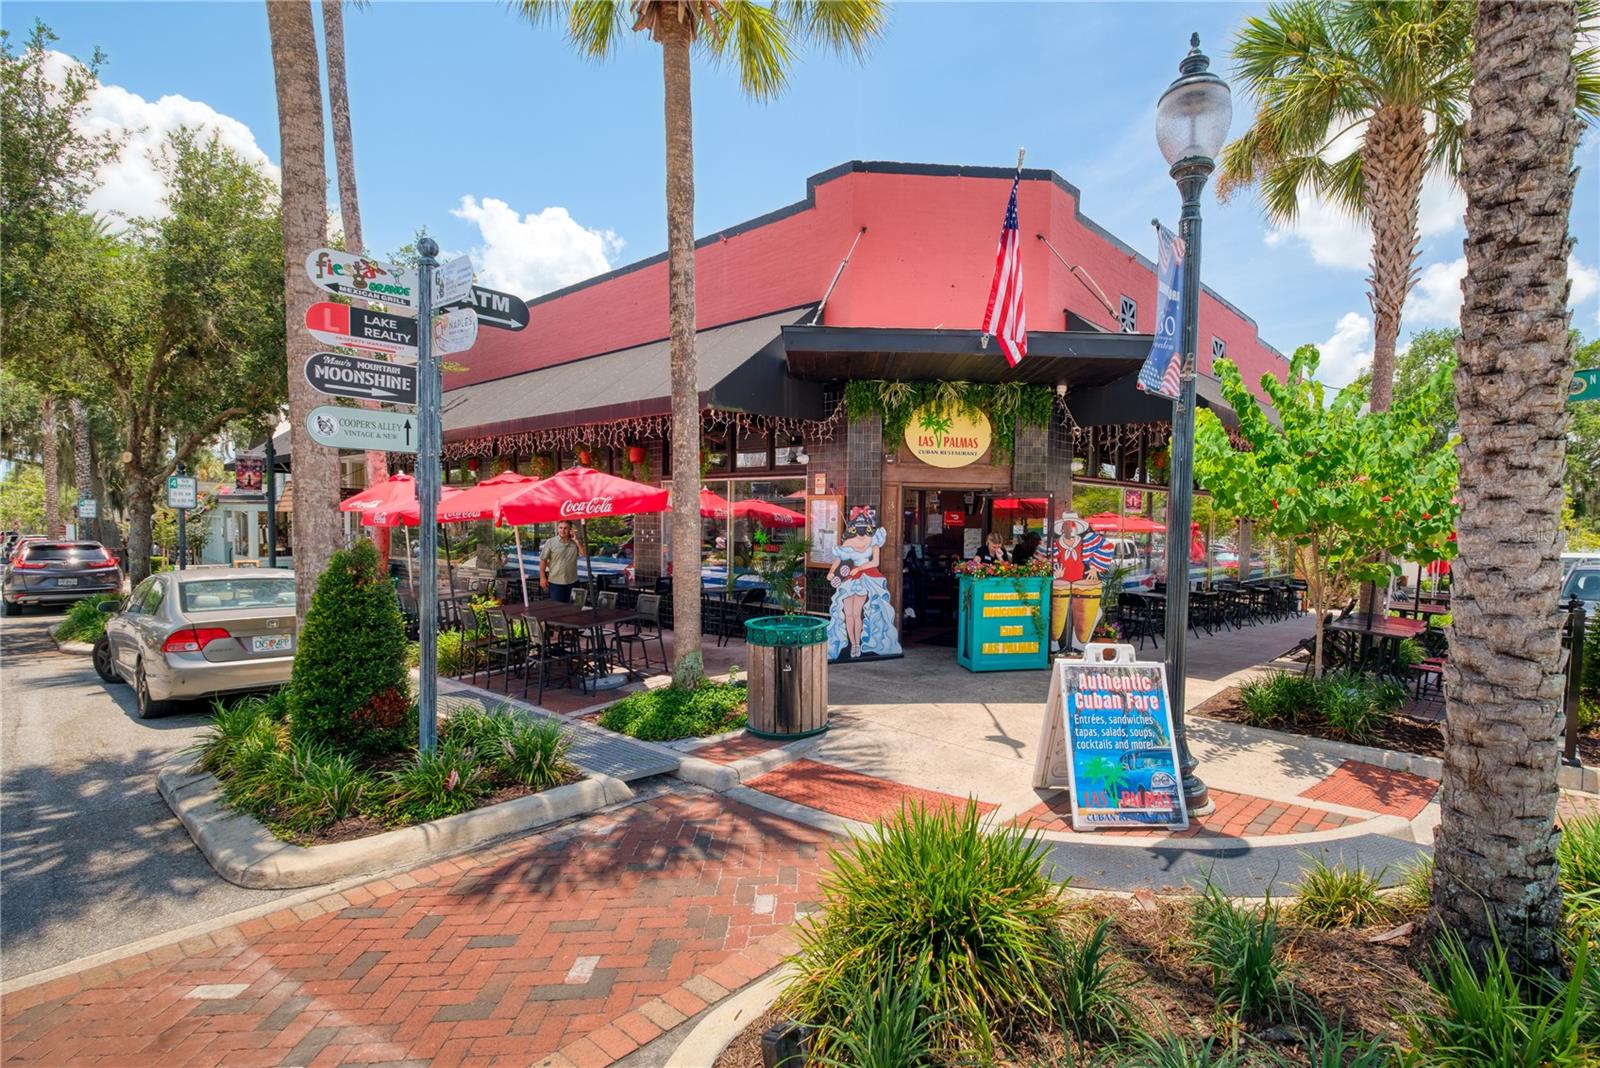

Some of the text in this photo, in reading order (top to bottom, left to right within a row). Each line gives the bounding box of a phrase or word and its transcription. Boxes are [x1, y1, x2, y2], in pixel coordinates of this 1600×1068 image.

[339, 285, 407, 305] MEXICAN GRILL
[462, 288, 510, 313] ATM
[364, 315, 397, 329] LAKE
[364, 327, 411, 343] REALTY
[336, 336, 405, 351] PROPERTY MANAGEMENT
[357, 361, 401, 375] MOUNTAIN
[315, 364, 412, 391] MOONSHINE
[1590, 374, 1597, 385] N
[339, 417, 402, 432] COOPER'S ALLEY
[343, 429, 374, 438] VINTAGE
[382, 432, 397, 440] NEW
[918, 436, 979, 449] LAS PALMAS
[1078, 673, 1152, 691] Authentic
[1074, 692, 1159, 711] Cuban Fare
[1074, 714, 1107, 725] Entrées,
[1075, 727, 1155, 739] tapas, salads, soups,
[1076, 739, 1154, 750] cocktails and more!
[1084, 790, 1173, 808] LAS PALMAS
[1087, 813, 1116, 822] CUBAN
